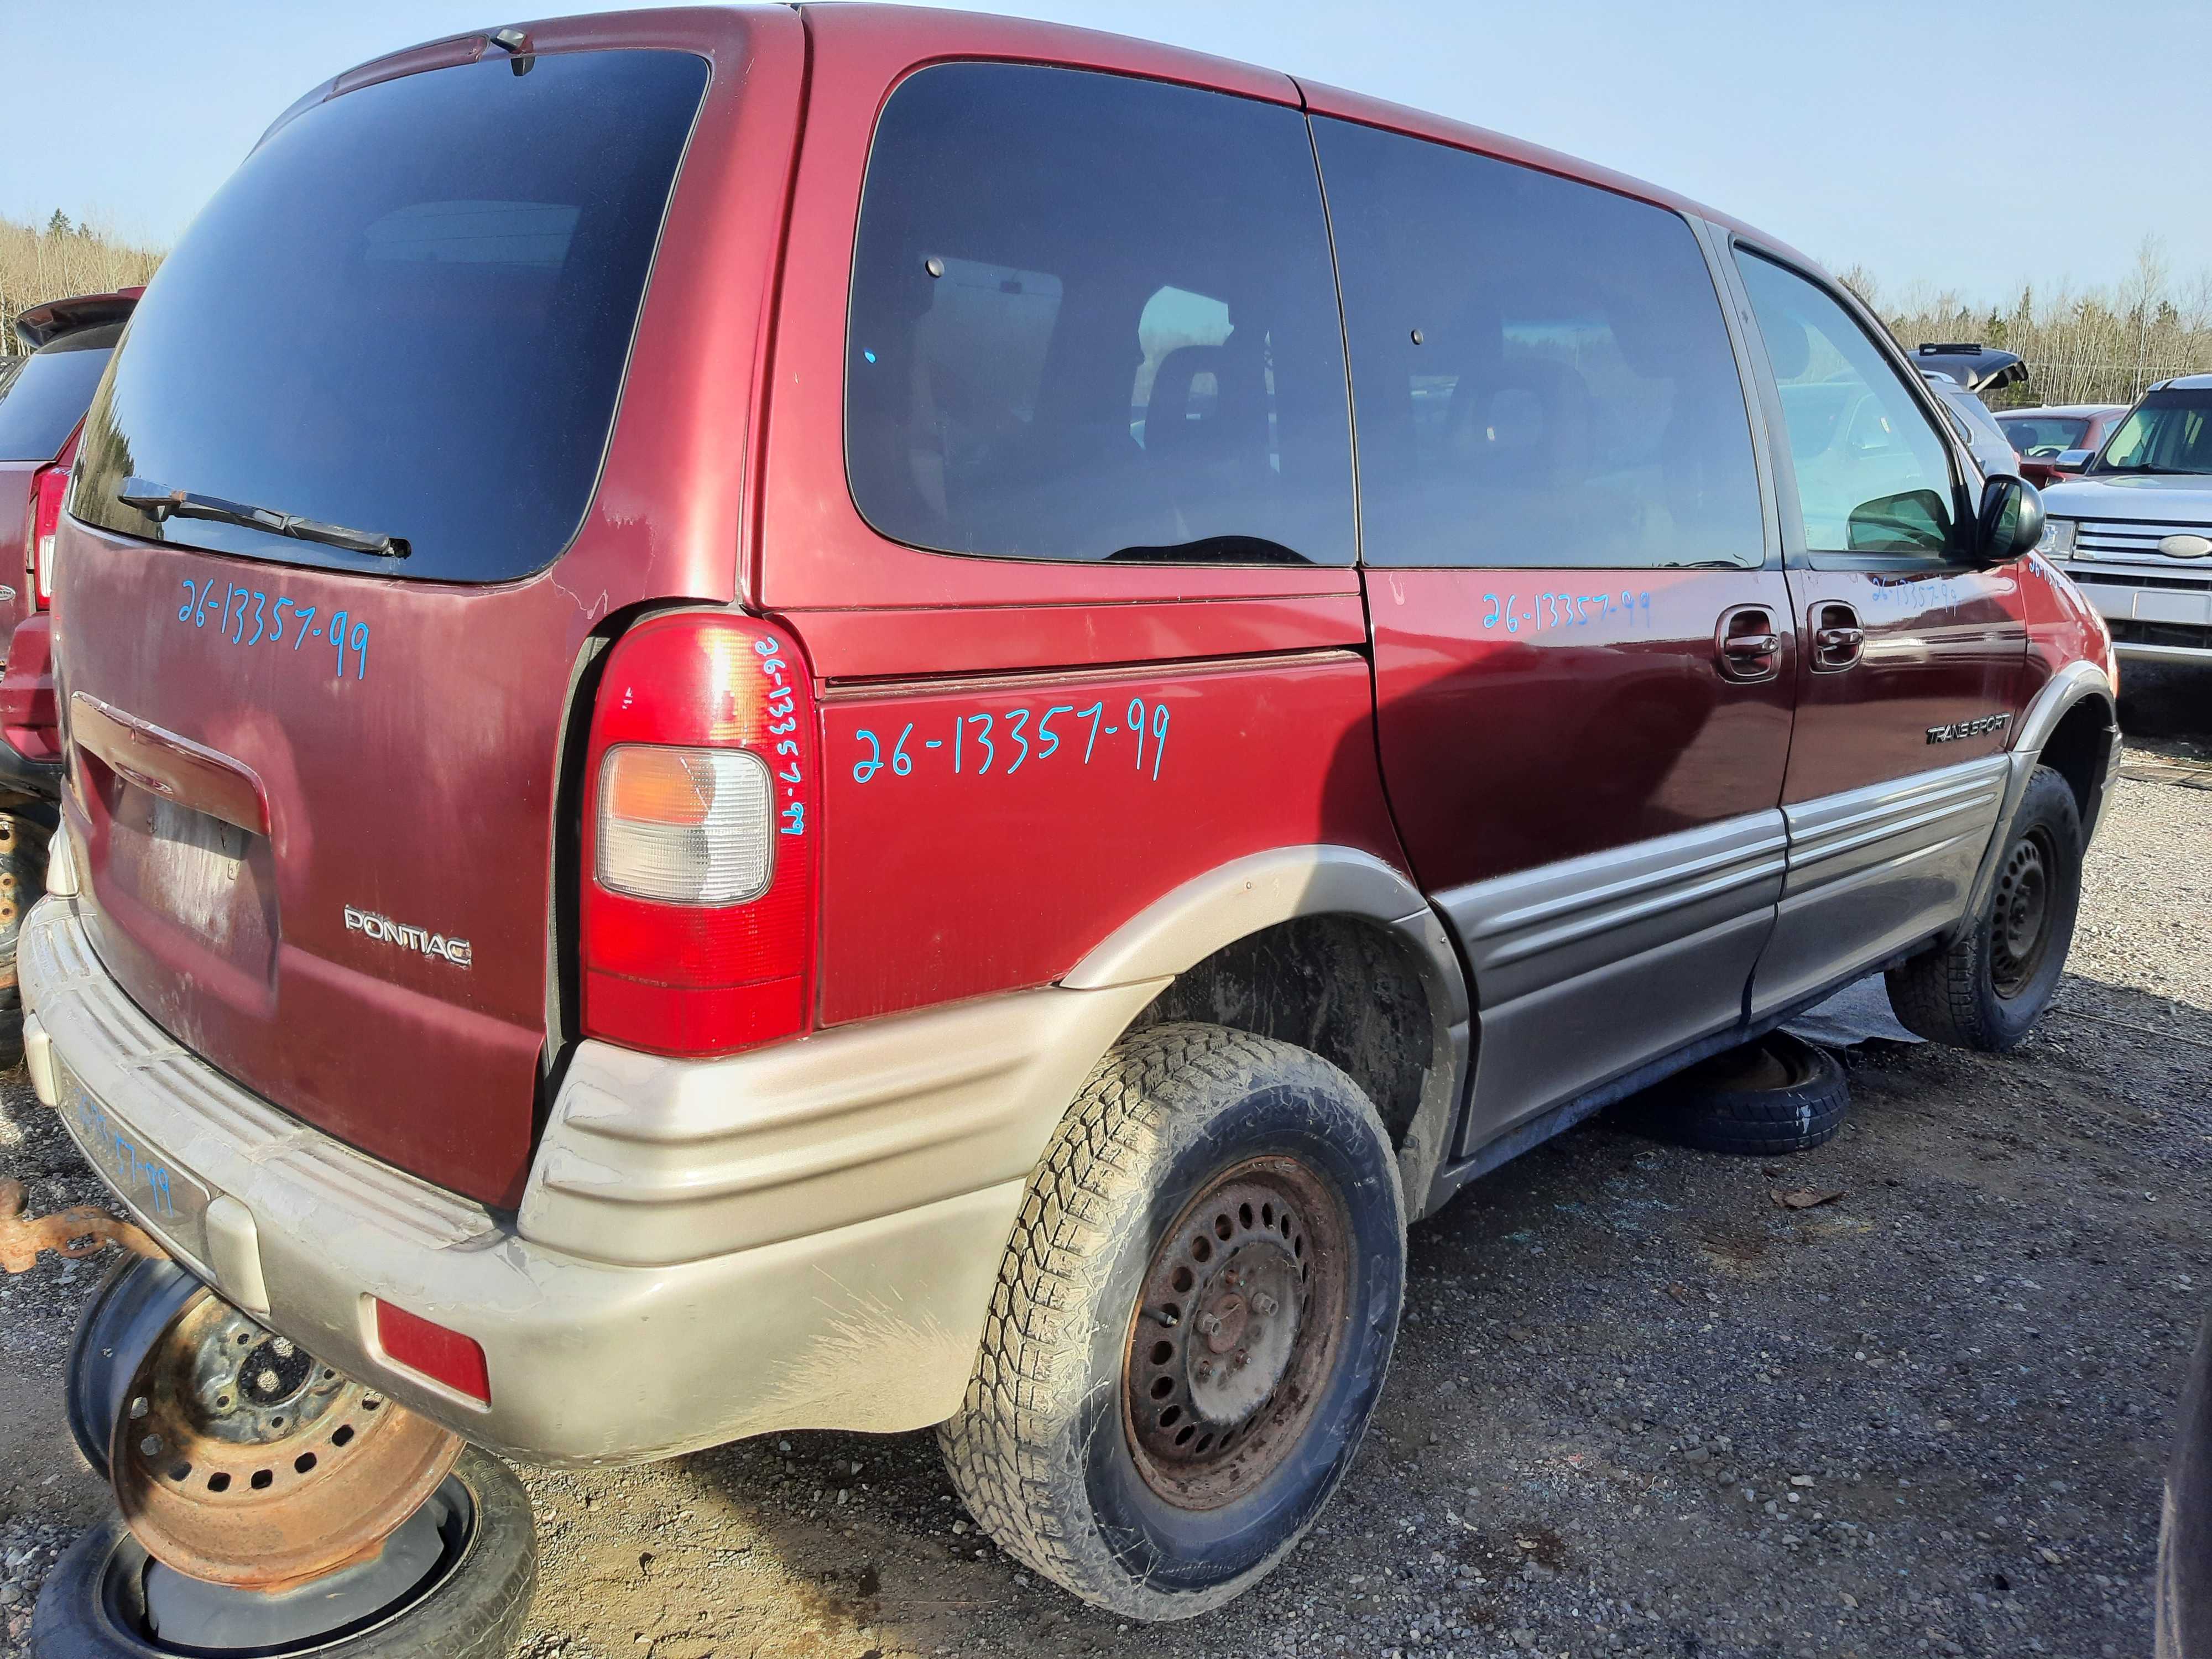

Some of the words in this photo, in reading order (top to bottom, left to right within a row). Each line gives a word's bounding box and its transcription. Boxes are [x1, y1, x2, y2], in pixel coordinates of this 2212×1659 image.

[178, 578, 369, 680] 26-13357-99
[1483, 591, 1651, 633] 26-13357-99
[754, 637, 805, 836] 26-13357-99
[852, 698, 1170, 781] 26-13357-99
[344, 904, 472, 967] PONTIAC
